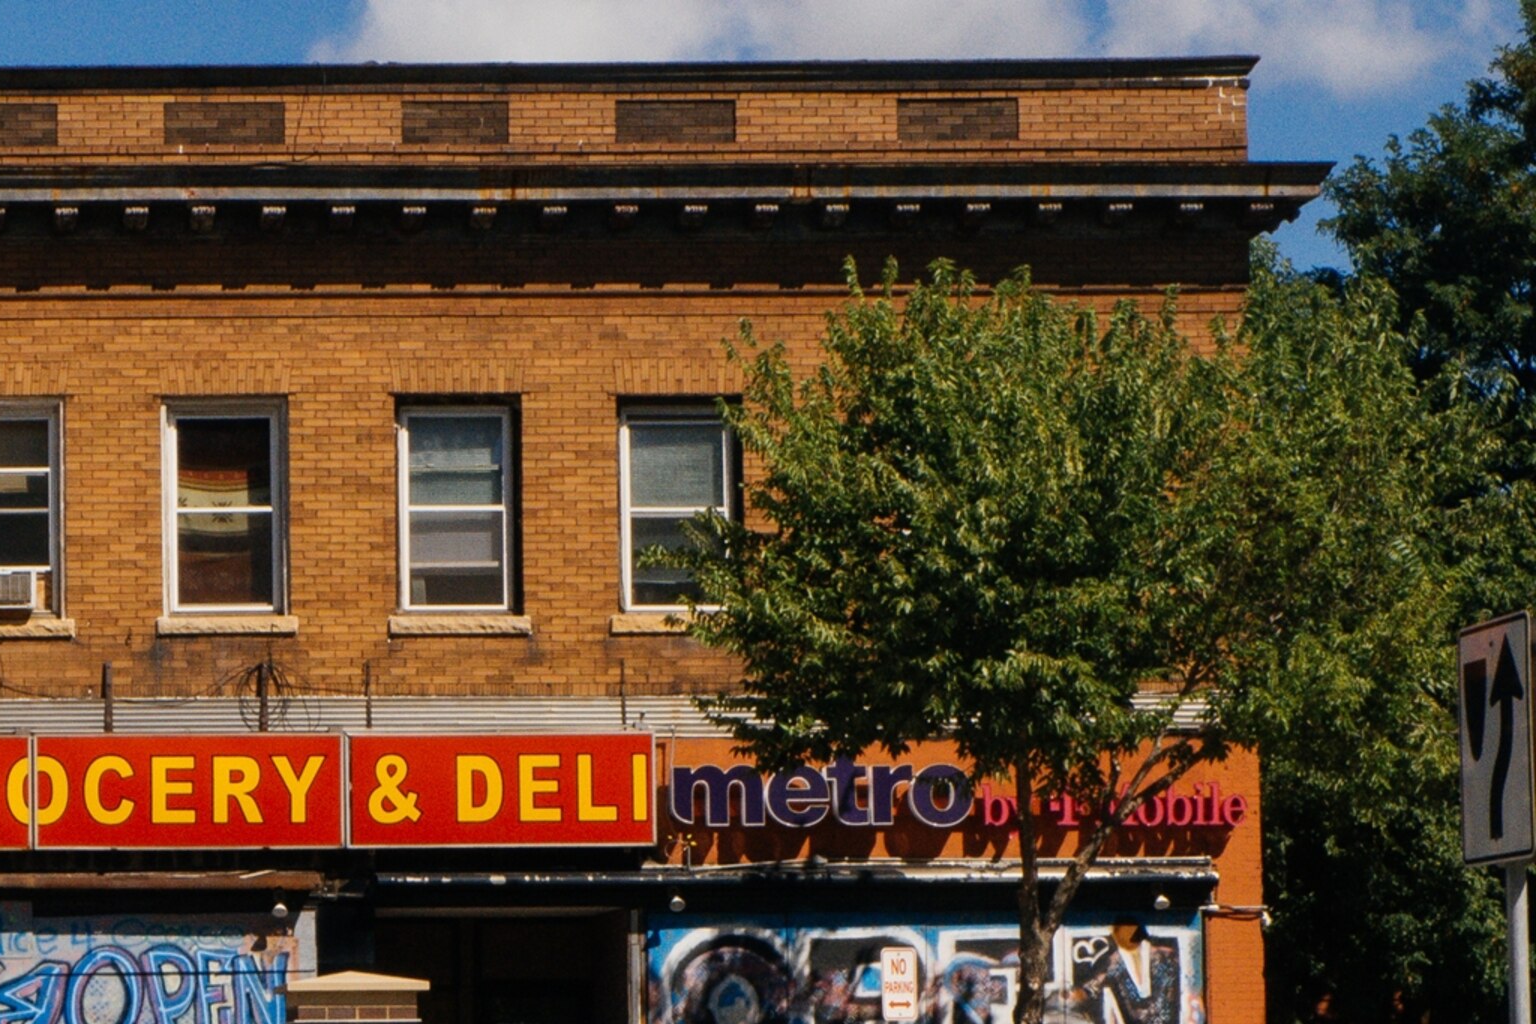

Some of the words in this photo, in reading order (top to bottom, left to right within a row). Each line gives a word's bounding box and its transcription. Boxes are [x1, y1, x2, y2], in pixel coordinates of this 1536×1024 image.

[367, 753, 423, 825] &
[455, 753, 648, 823] DELI
[669, 755, 974, 828] metro
[884, 981, 914, 993] PARKING
[890, 958, 907, 976] NO
